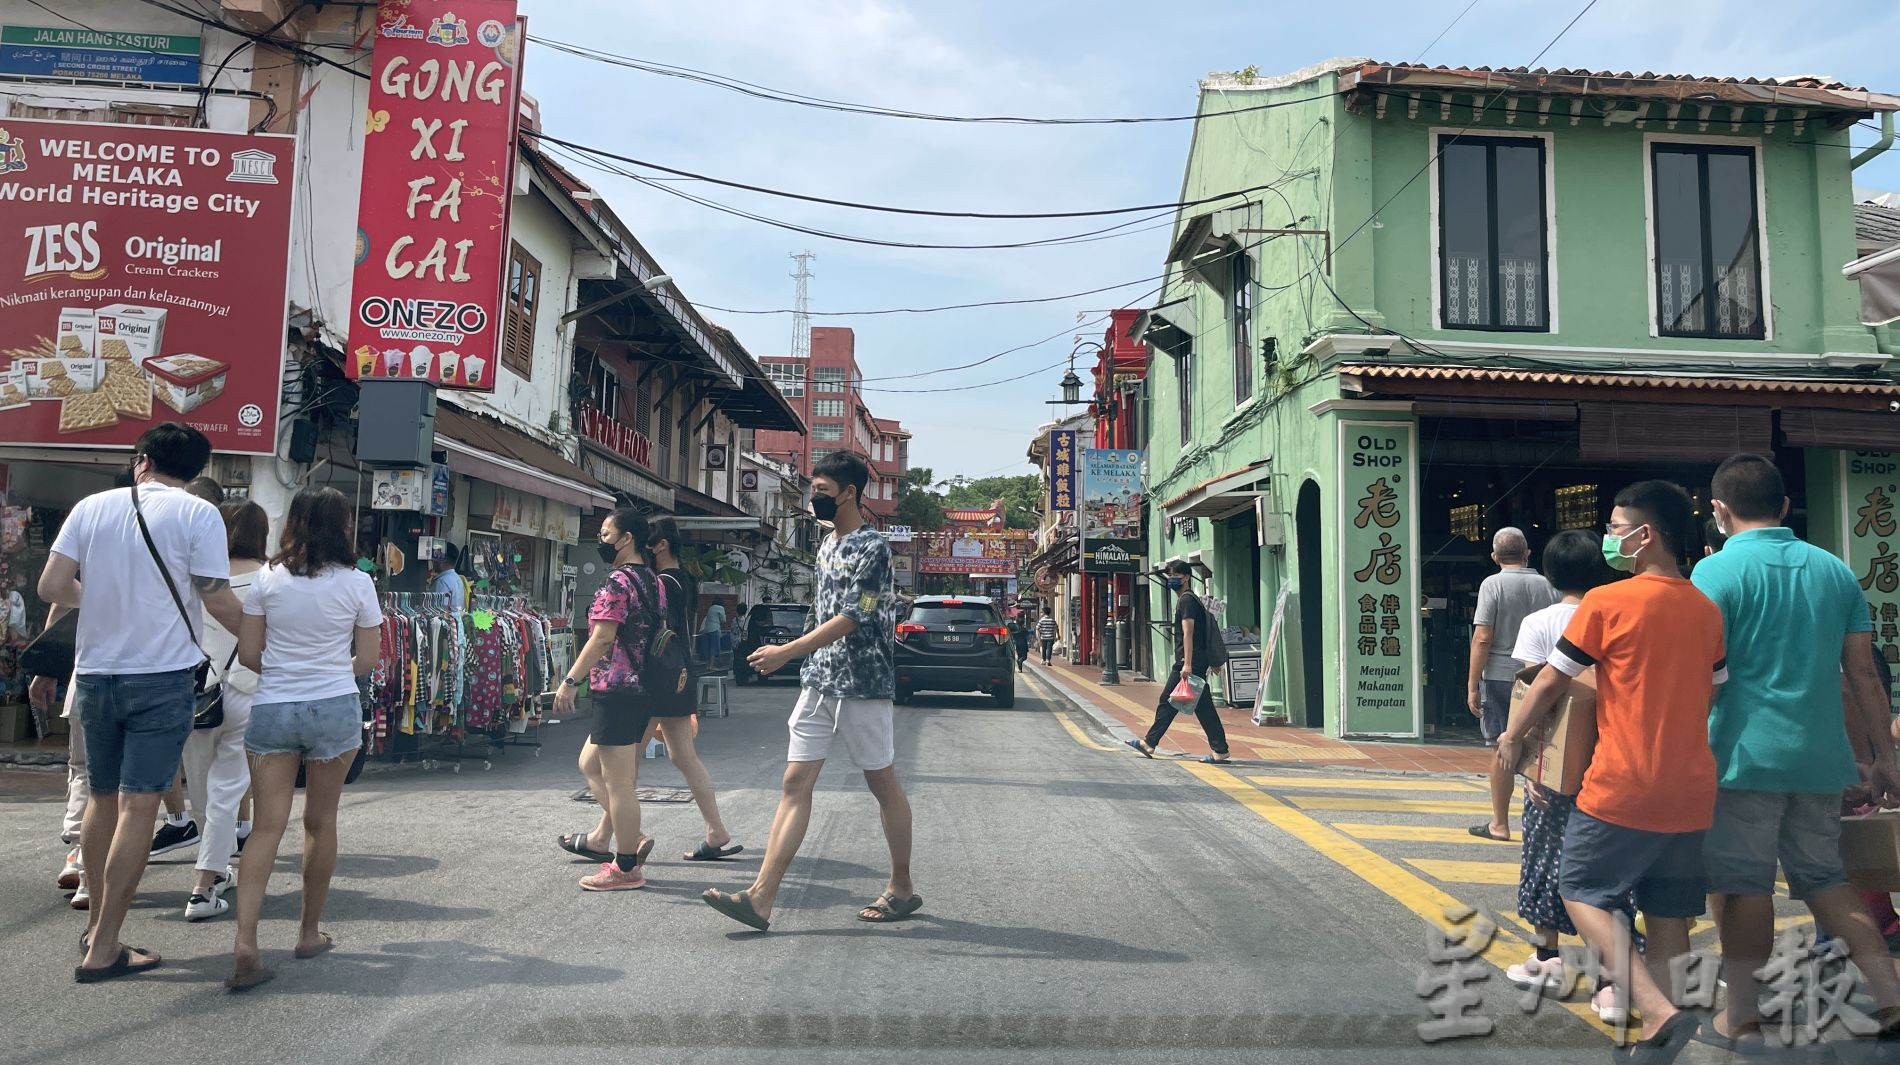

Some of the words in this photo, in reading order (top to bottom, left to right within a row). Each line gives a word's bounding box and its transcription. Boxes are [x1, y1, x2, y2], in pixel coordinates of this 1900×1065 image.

[34, 30, 74, 44] JALAN
[77, 32, 113, 46] HANG
[116, 34, 170, 50] KASTURI
[381, 56, 505, 104] GONG
[410, 117, 468, 161] XI
[40, 139, 175, 165] WELCOME
[184, 147, 220, 167] TO
[73, 163, 183, 187] MELAKA
[235, 159, 272, 175] UNESCO
[0, 182, 72, 203] World
[83, 186, 199, 214] Heritage
[208, 195, 260, 218] City
[406, 176, 461, 223] FA
[24, 220, 101, 278] ZESS
[125, 236, 222, 265] Original
[385, 235, 474, 282] CAI
[125, 264, 164, 276] Cream
[167, 266, 219, 279] Crackers
[0, 288, 48, 308] Nikmati
[50, 286, 121, 301] kerangupan
[124, 286, 147, 299] dan
[149, 287, 230, 317] kelazatannya!
[119, 322, 151, 334] Original
[361, 298, 486, 333] ONEZO
[381, 327, 463, 344] www.onezo.my
[70, 363, 93, 371] Original
[1357, 435, 1397, 450] OLD
[1055, 432, 1070, 508] 古城雞飯粒
[1103, 469, 1136, 477] MELAKA
[1352, 452, 1402, 468] SHOP
[1851, 459, 1897, 474] SHOP
[1354, 477, 1401, 586] 老店
[1854, 486, 1899, 593] 老店
[1095, 551, 1130, 561] HIMALAYA
[1358, 593, 1377, 656] 食品行
[1380, 593, 1401, 656] 伴手禮
[1359, 664, 1400, 678] Menjual
[1357, 680, 1404, 692] Makanan
[1356, 696, 1406, 709] Tempatan
